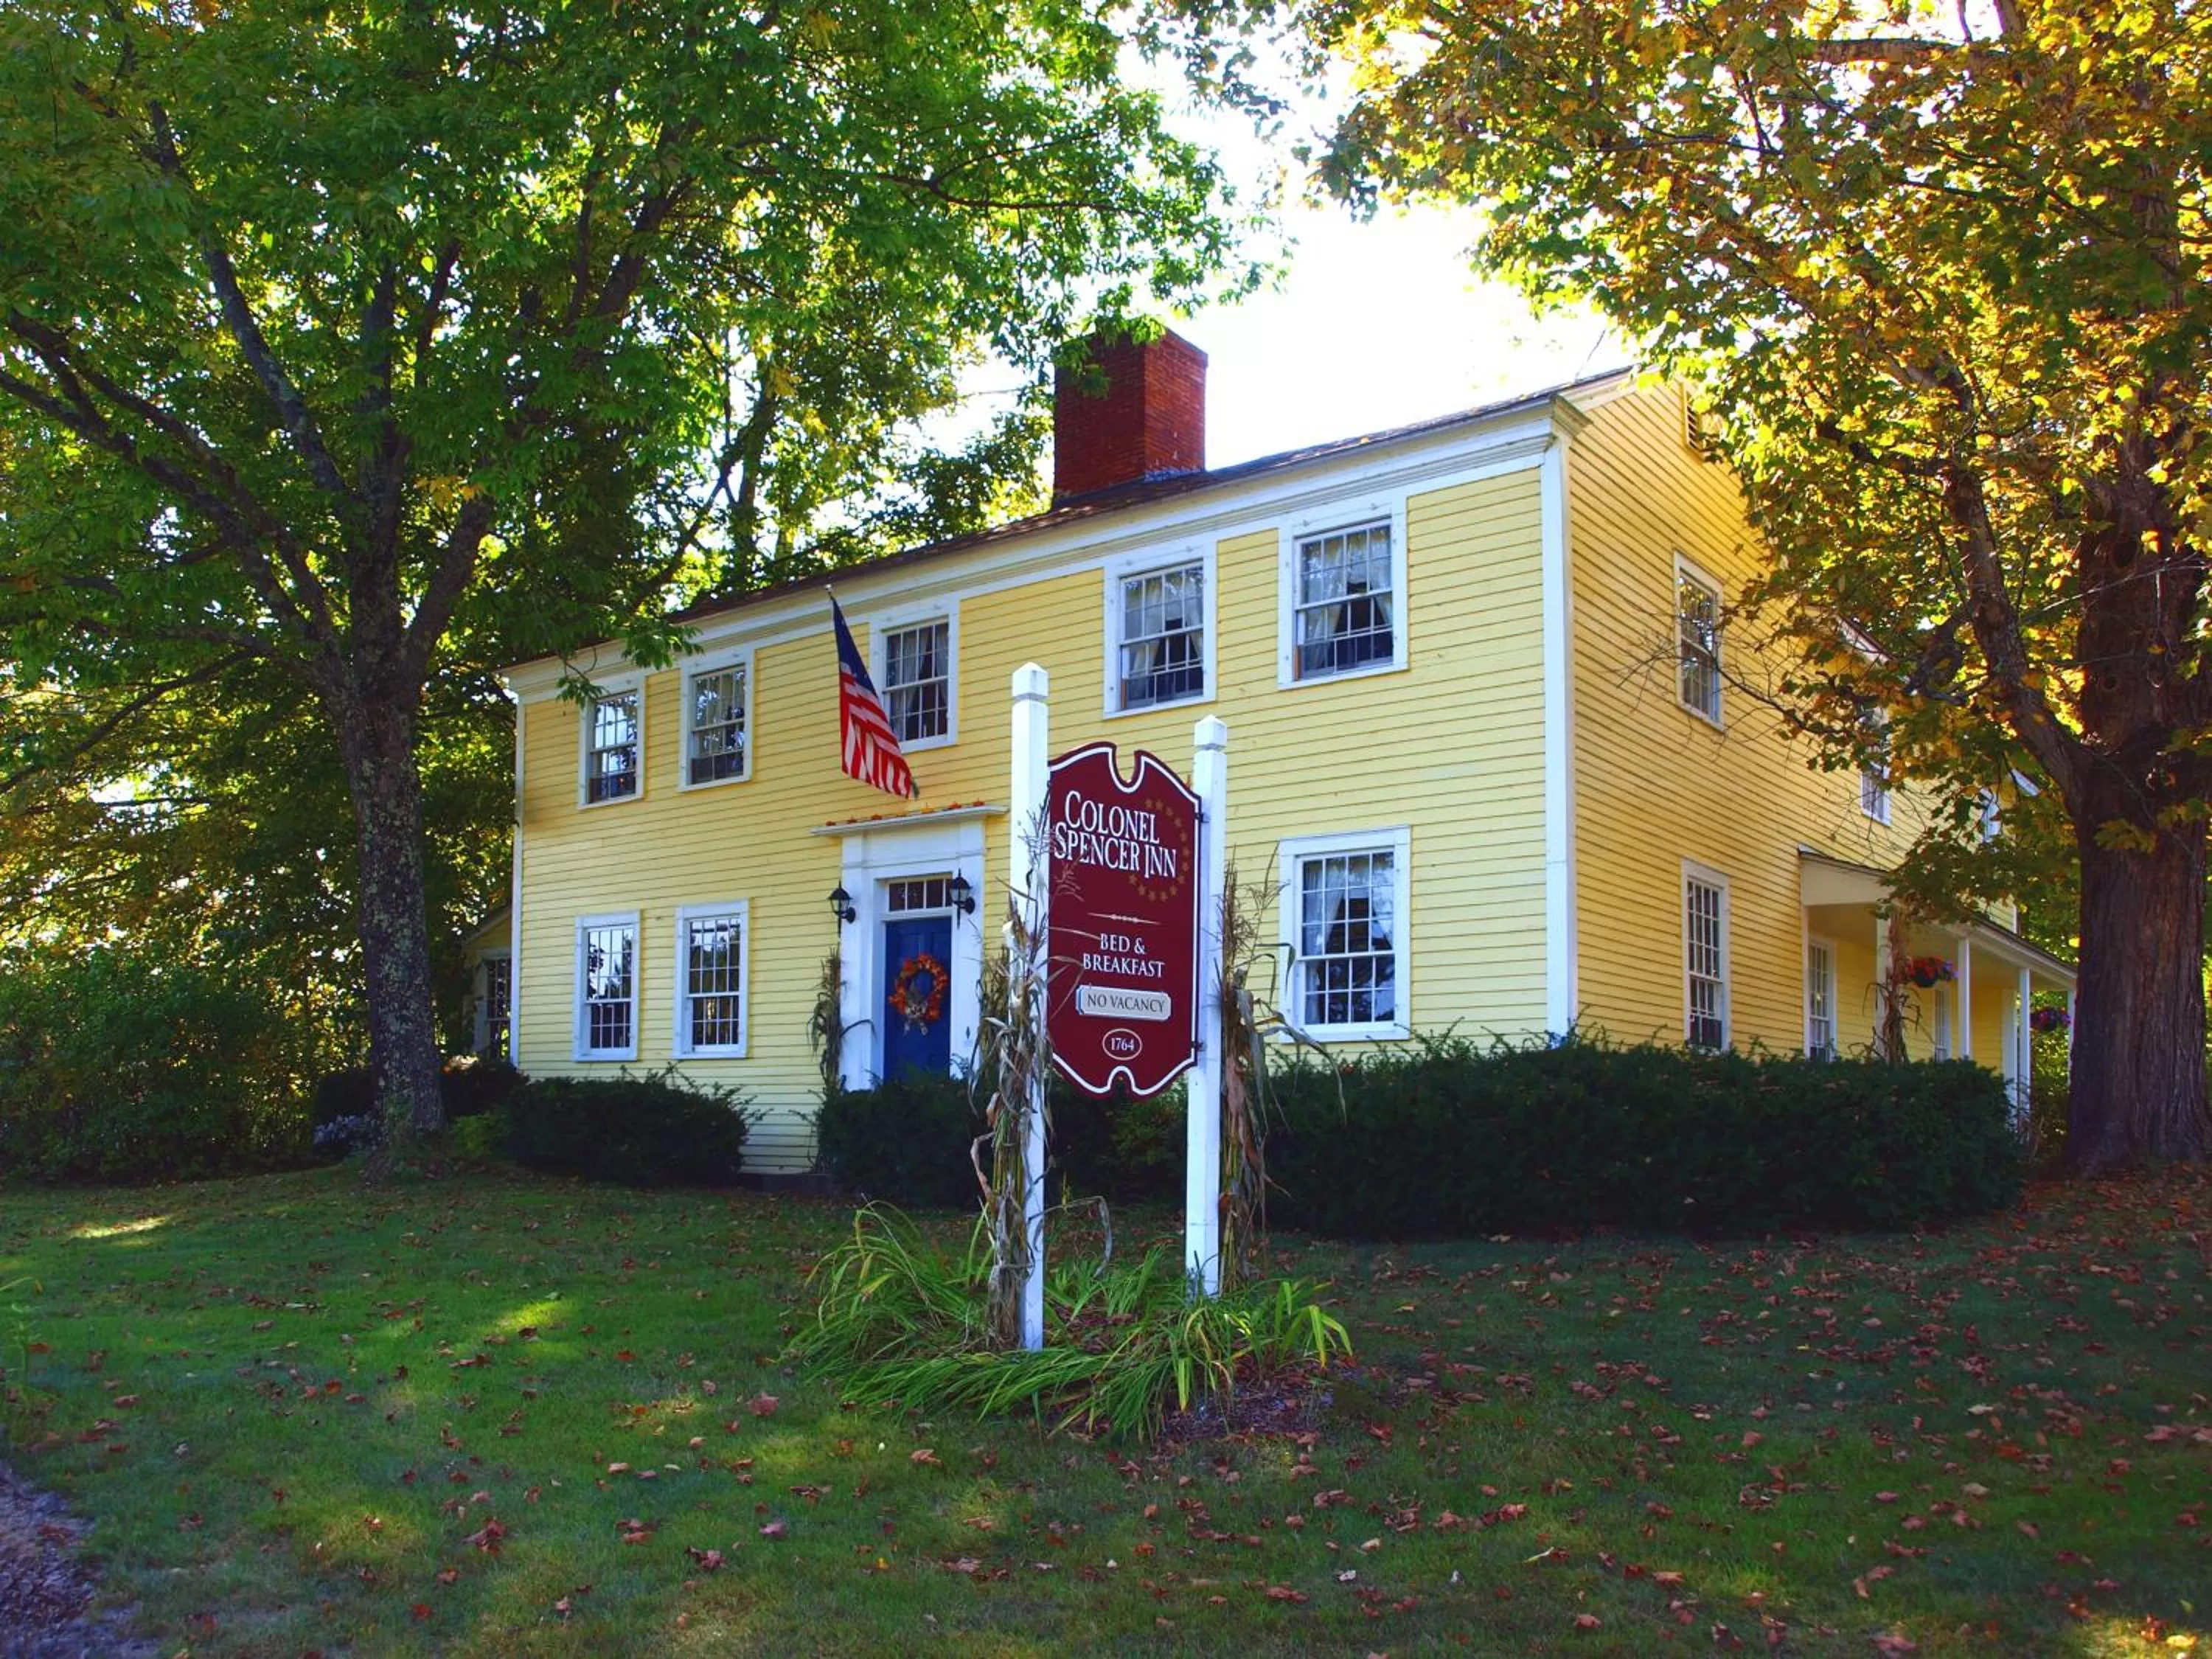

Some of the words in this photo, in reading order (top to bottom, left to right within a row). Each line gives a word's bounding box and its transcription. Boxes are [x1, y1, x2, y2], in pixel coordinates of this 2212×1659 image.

[1065, 790, 1160, 844] COLONEL
[1054, 821, 1140, 872] SPENCER
[1144, 844, 1177, 879] INN
[1100, 933, 1130, 953] BED
[1134, 938, 1147, 955] &
[1082, 953, 1165, 978] BREAKFAST
[1088, 994, 1107, 1007] NO
[1110, 996, 1166, 1013] VACANCY
[1110, 1037, 1135, 1051] 1764
